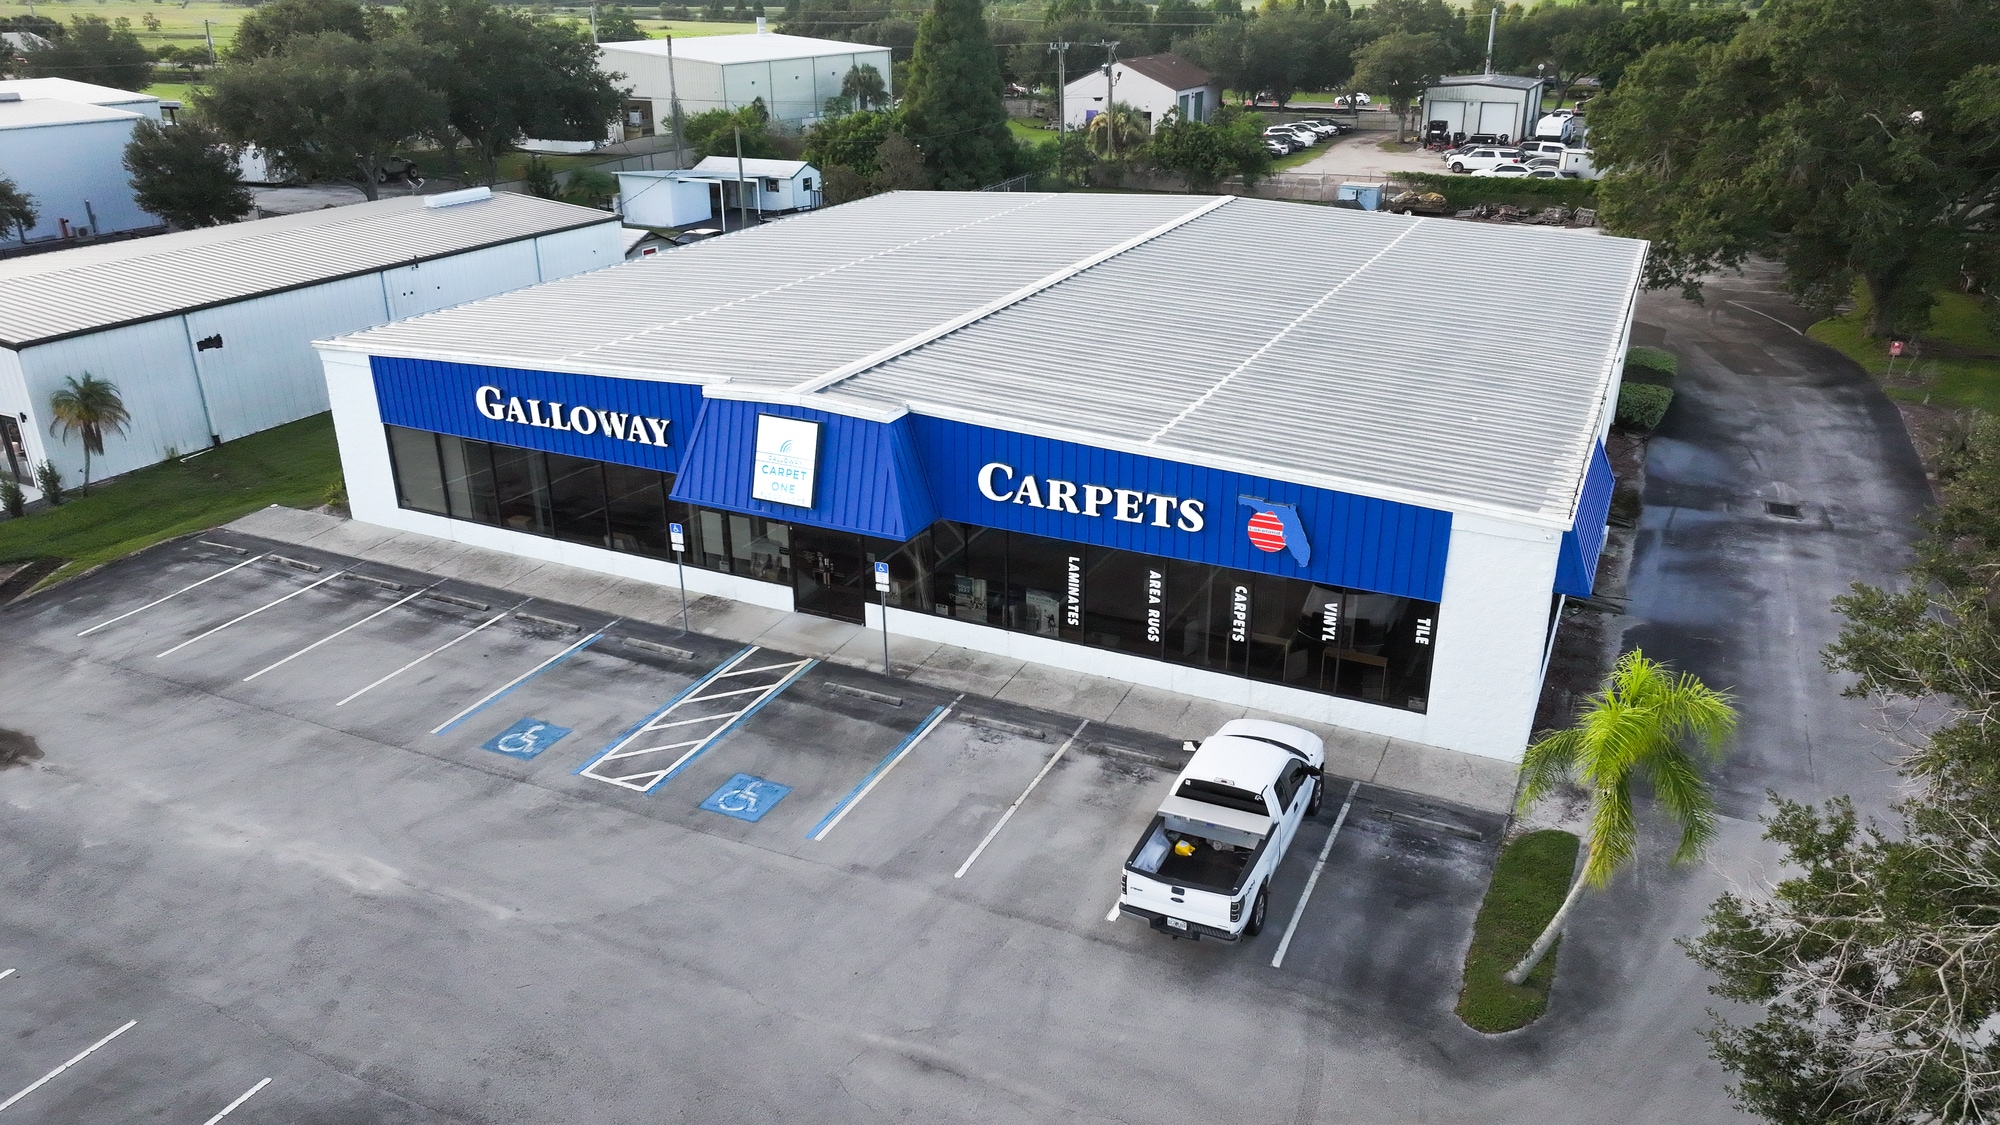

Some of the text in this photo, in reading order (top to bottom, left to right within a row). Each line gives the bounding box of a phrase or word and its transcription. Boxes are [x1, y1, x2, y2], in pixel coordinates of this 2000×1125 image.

[476, 385, 670, 448] GALLOWAY
[761, 464, 807, 481] CARPET
[768, 455, 803, 466] GALLOWAY
[771, 481, 796, 495] ONE
[977, 462, 1205, 533] CARPETS
[1067, 556, 1080, 626] LAMINATES
[1147, 570, 1162, 643] AREA RUGS
[1231, 585, 1248, 643] CARPETS
[1321, 602, 1338, 642] VINYL
[1415, 618, 1432, 646] TILE
